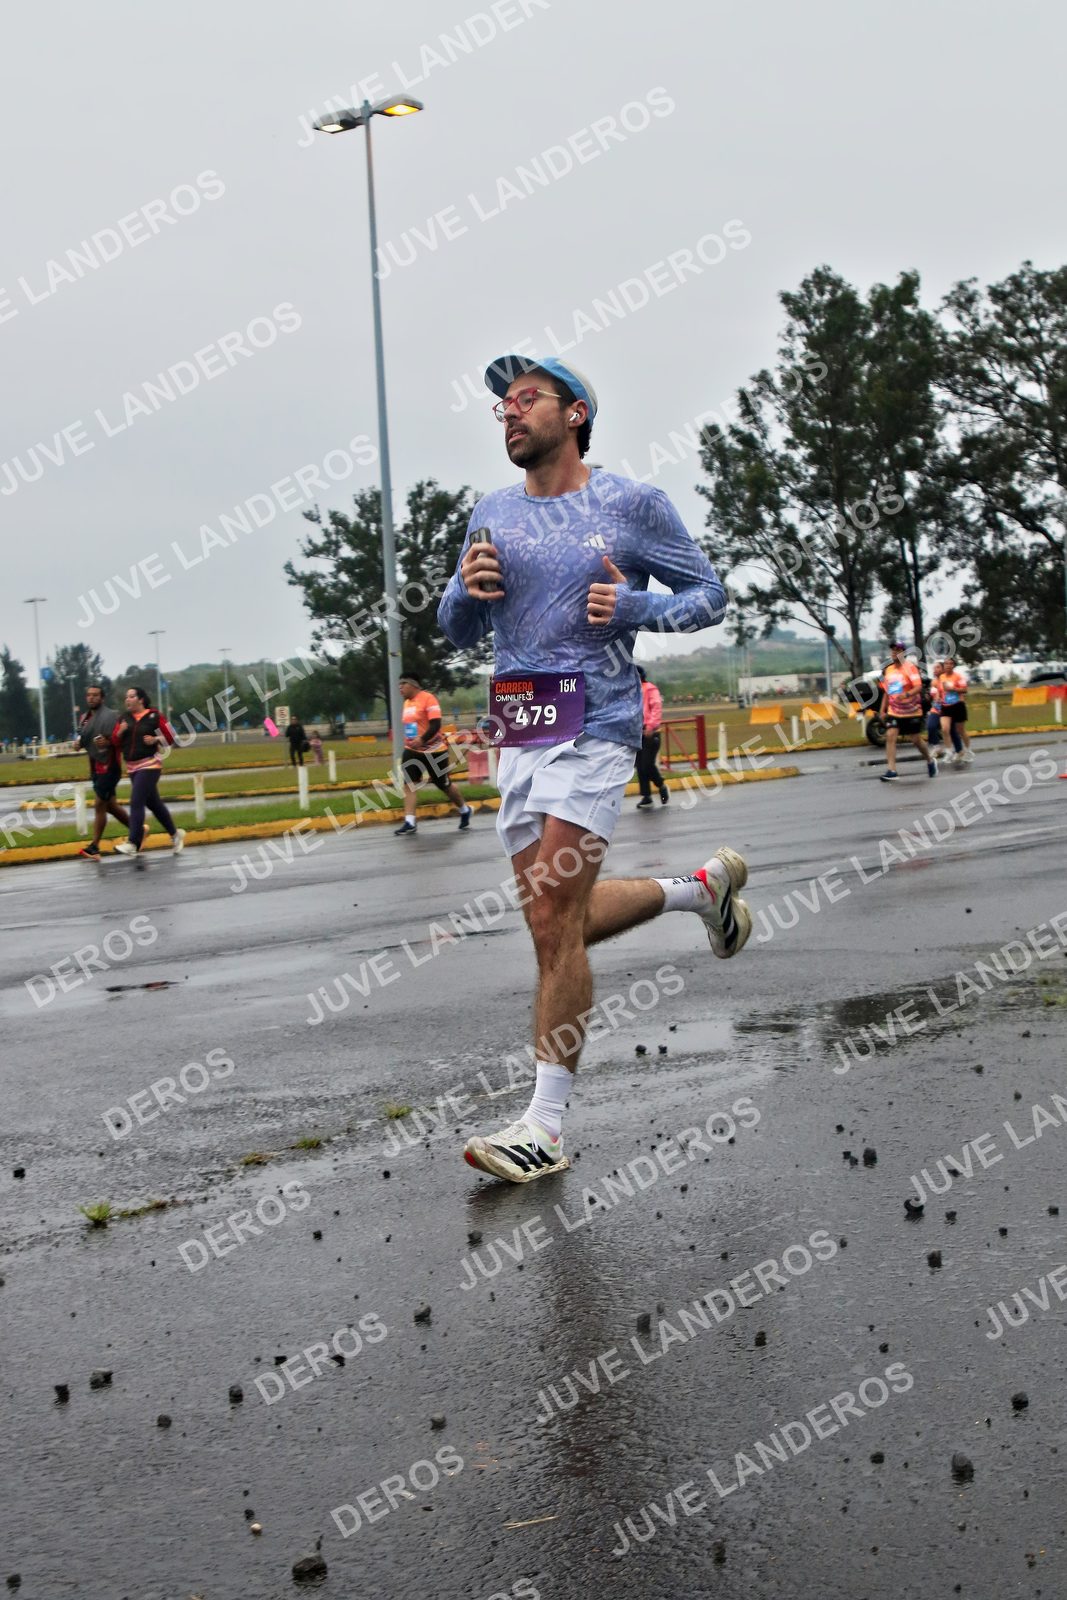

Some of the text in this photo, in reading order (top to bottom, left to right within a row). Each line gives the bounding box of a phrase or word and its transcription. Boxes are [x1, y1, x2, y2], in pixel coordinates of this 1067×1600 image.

[495, 682, 533, 693] CARRERA
[559, 679, 577, 692] 15K
[495, 694, 525, 702] OMNILIFE
[515, 705, 557, 726] 479
